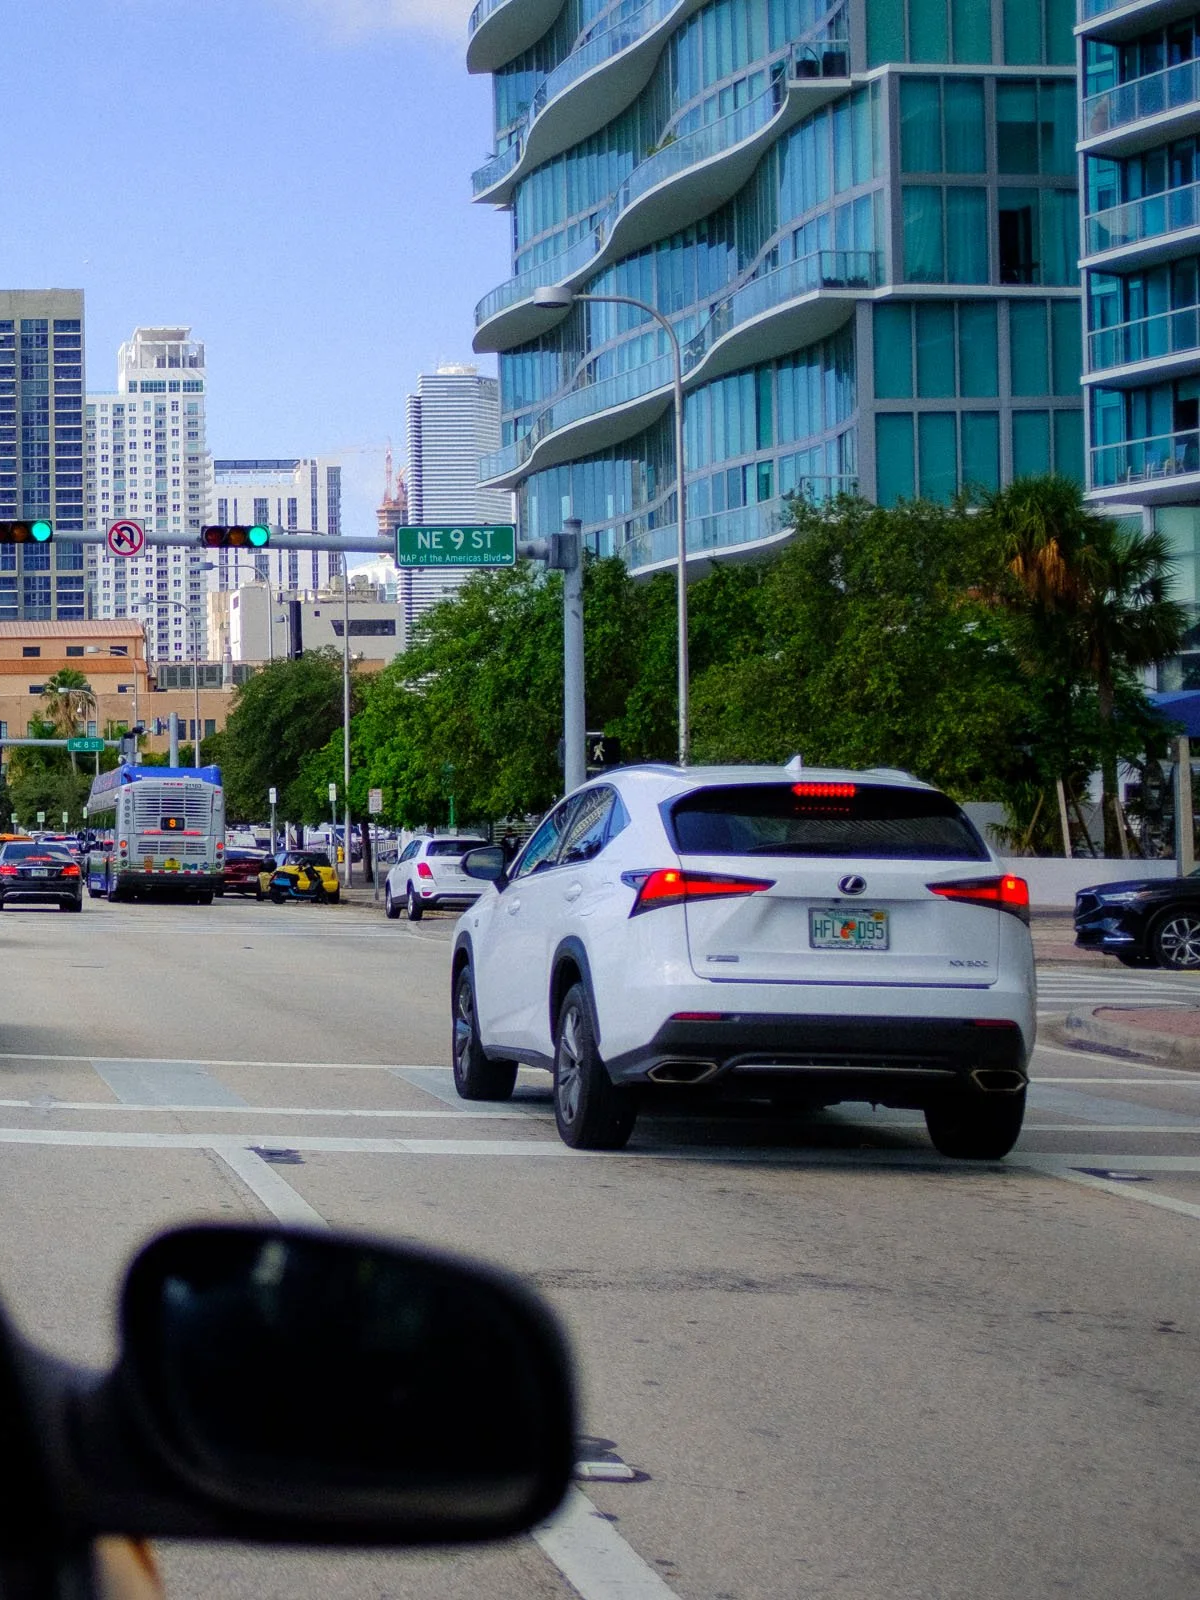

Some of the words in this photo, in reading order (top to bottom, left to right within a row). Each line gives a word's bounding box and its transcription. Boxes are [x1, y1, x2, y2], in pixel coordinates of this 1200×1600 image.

[417, 531, 443, 549] NE
[449, 529, 464, 550] 9
[471, 530, 494, 548] ST
[400, 554, 417, 563] NAP
[419, 554, 427, 562] of
[429, 553, 443, 562] the
[445, 554, 481, 562] Americas
[483, 553, 501, 562] Blvd
[814, 919, 840, 938] HFL
